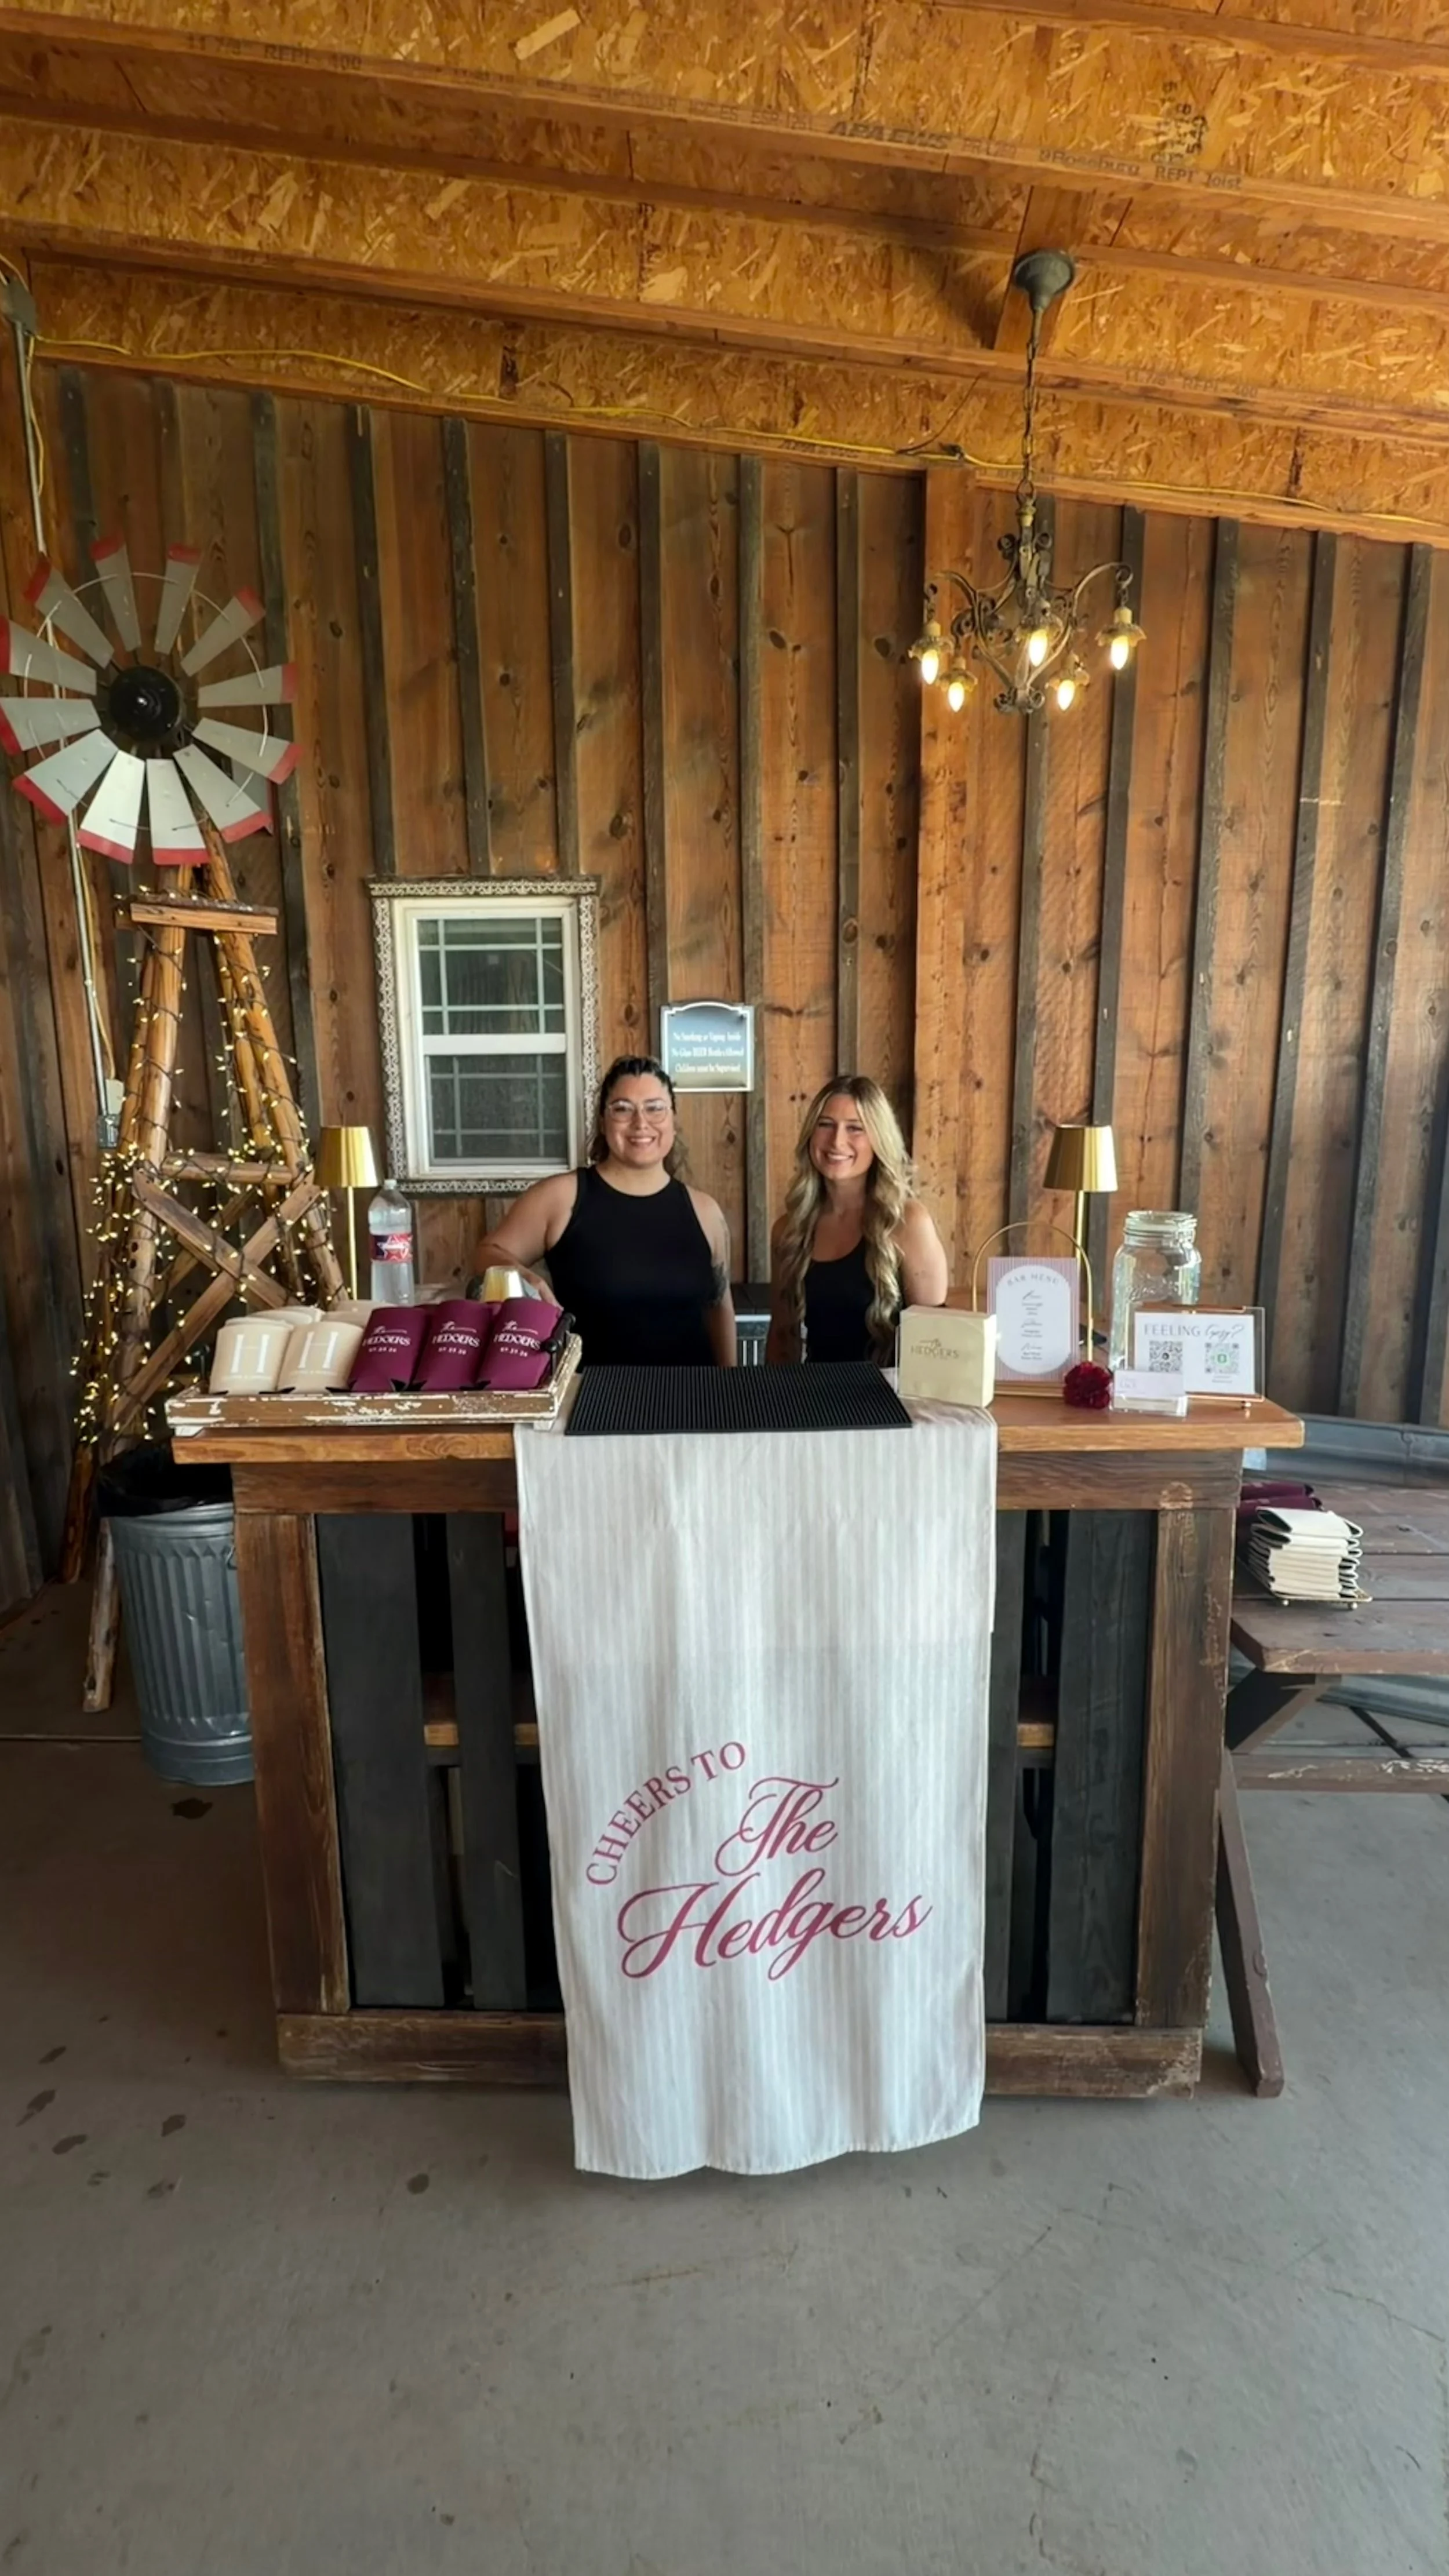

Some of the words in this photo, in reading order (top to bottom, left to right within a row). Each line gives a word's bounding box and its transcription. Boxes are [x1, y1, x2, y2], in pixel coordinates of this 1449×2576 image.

[362, 1335, 412, 1347] HEDGERS
[432, 1332, 480, 1348] HEDGERS
[493, 1333, 541, 1351] HEDGERS
[1144, 1323, 1201, 1337] FEELING
[231, 1333, 270, 1373] H
[298, 1331, 339, 1369] H
[910, 1345, 960, 1360] HEDGERS
[585, 1765, 691, 1886] CHEERS
[690, 1741, 747, 1783] TO
[714, 1776, 839, 1877] The
[617, 1867, 934, 1981] Hedgers
